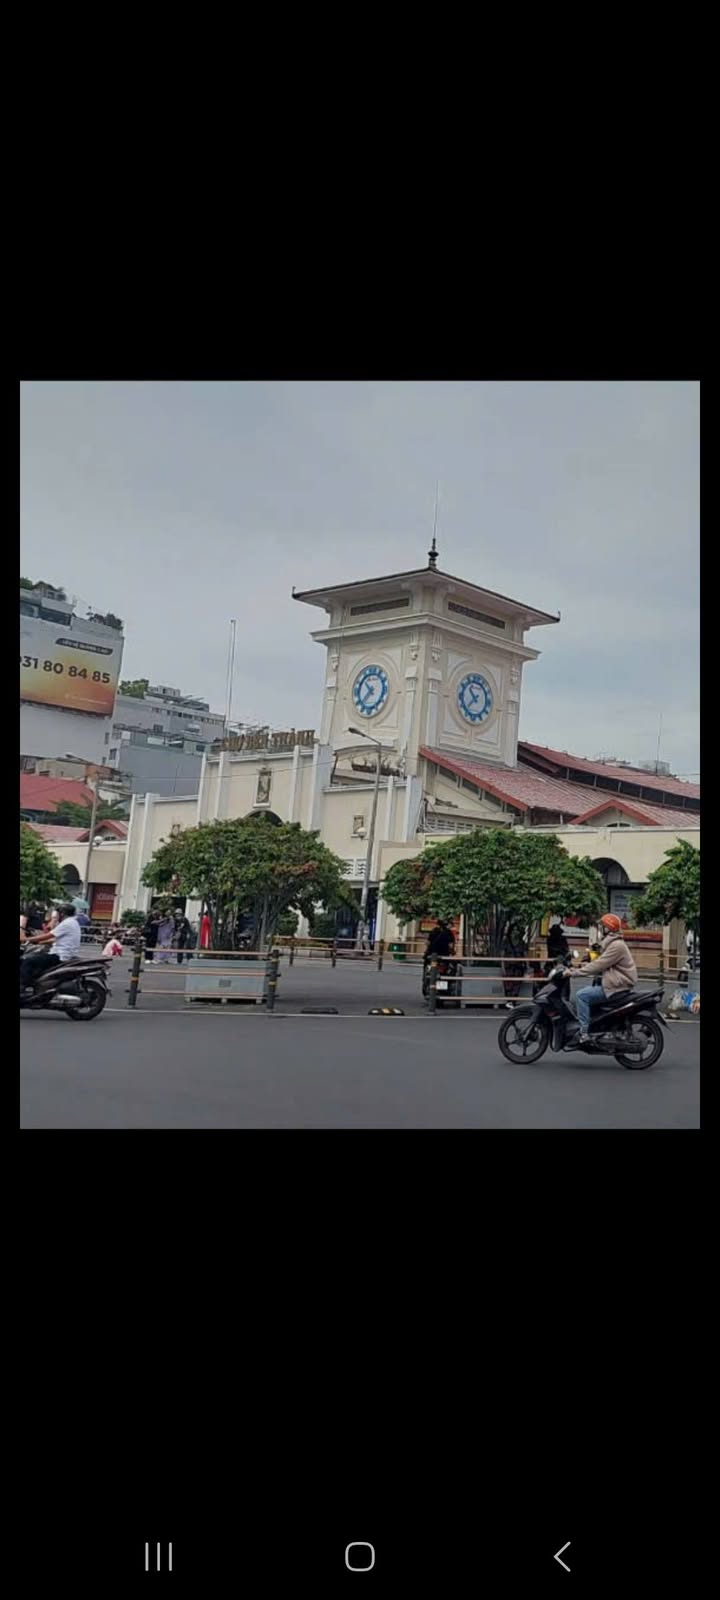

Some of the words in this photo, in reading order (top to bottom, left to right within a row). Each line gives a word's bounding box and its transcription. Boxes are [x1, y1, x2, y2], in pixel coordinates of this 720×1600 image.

[43, 660, 64, 674] 80
[68, 665, 88, 680] 84
[92, 670, 111, 684] 85
